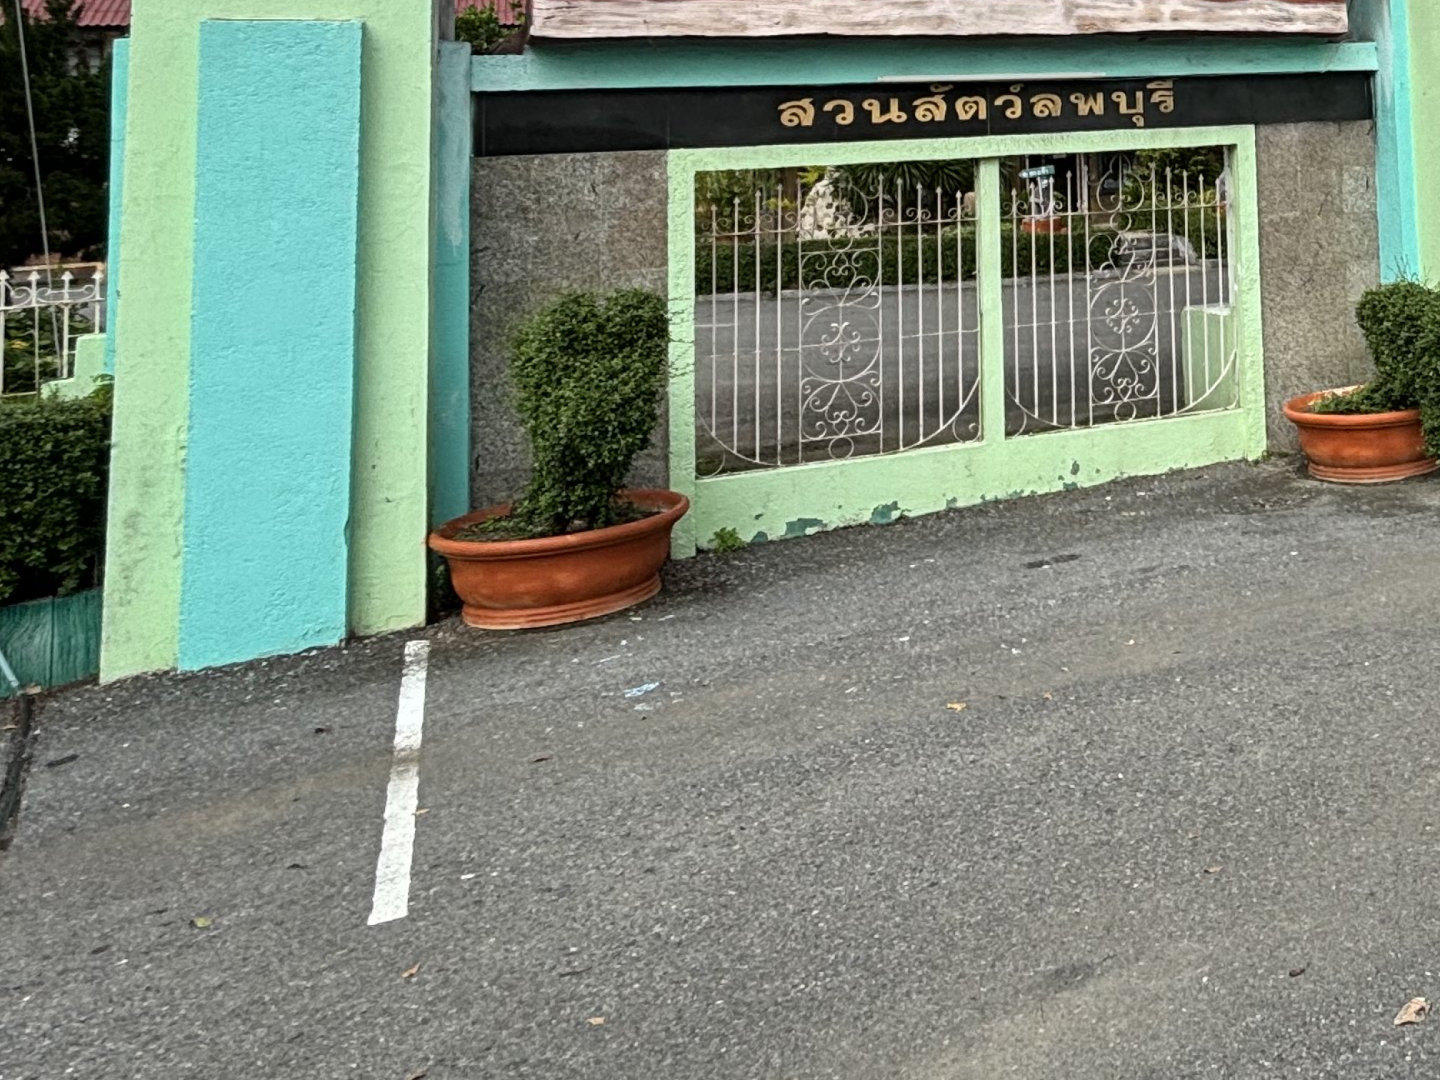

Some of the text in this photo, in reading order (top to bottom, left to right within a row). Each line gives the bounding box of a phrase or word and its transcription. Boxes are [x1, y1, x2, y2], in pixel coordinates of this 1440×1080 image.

[777, 79, 1175, 127] สวนสัตว์ลพบุรี
